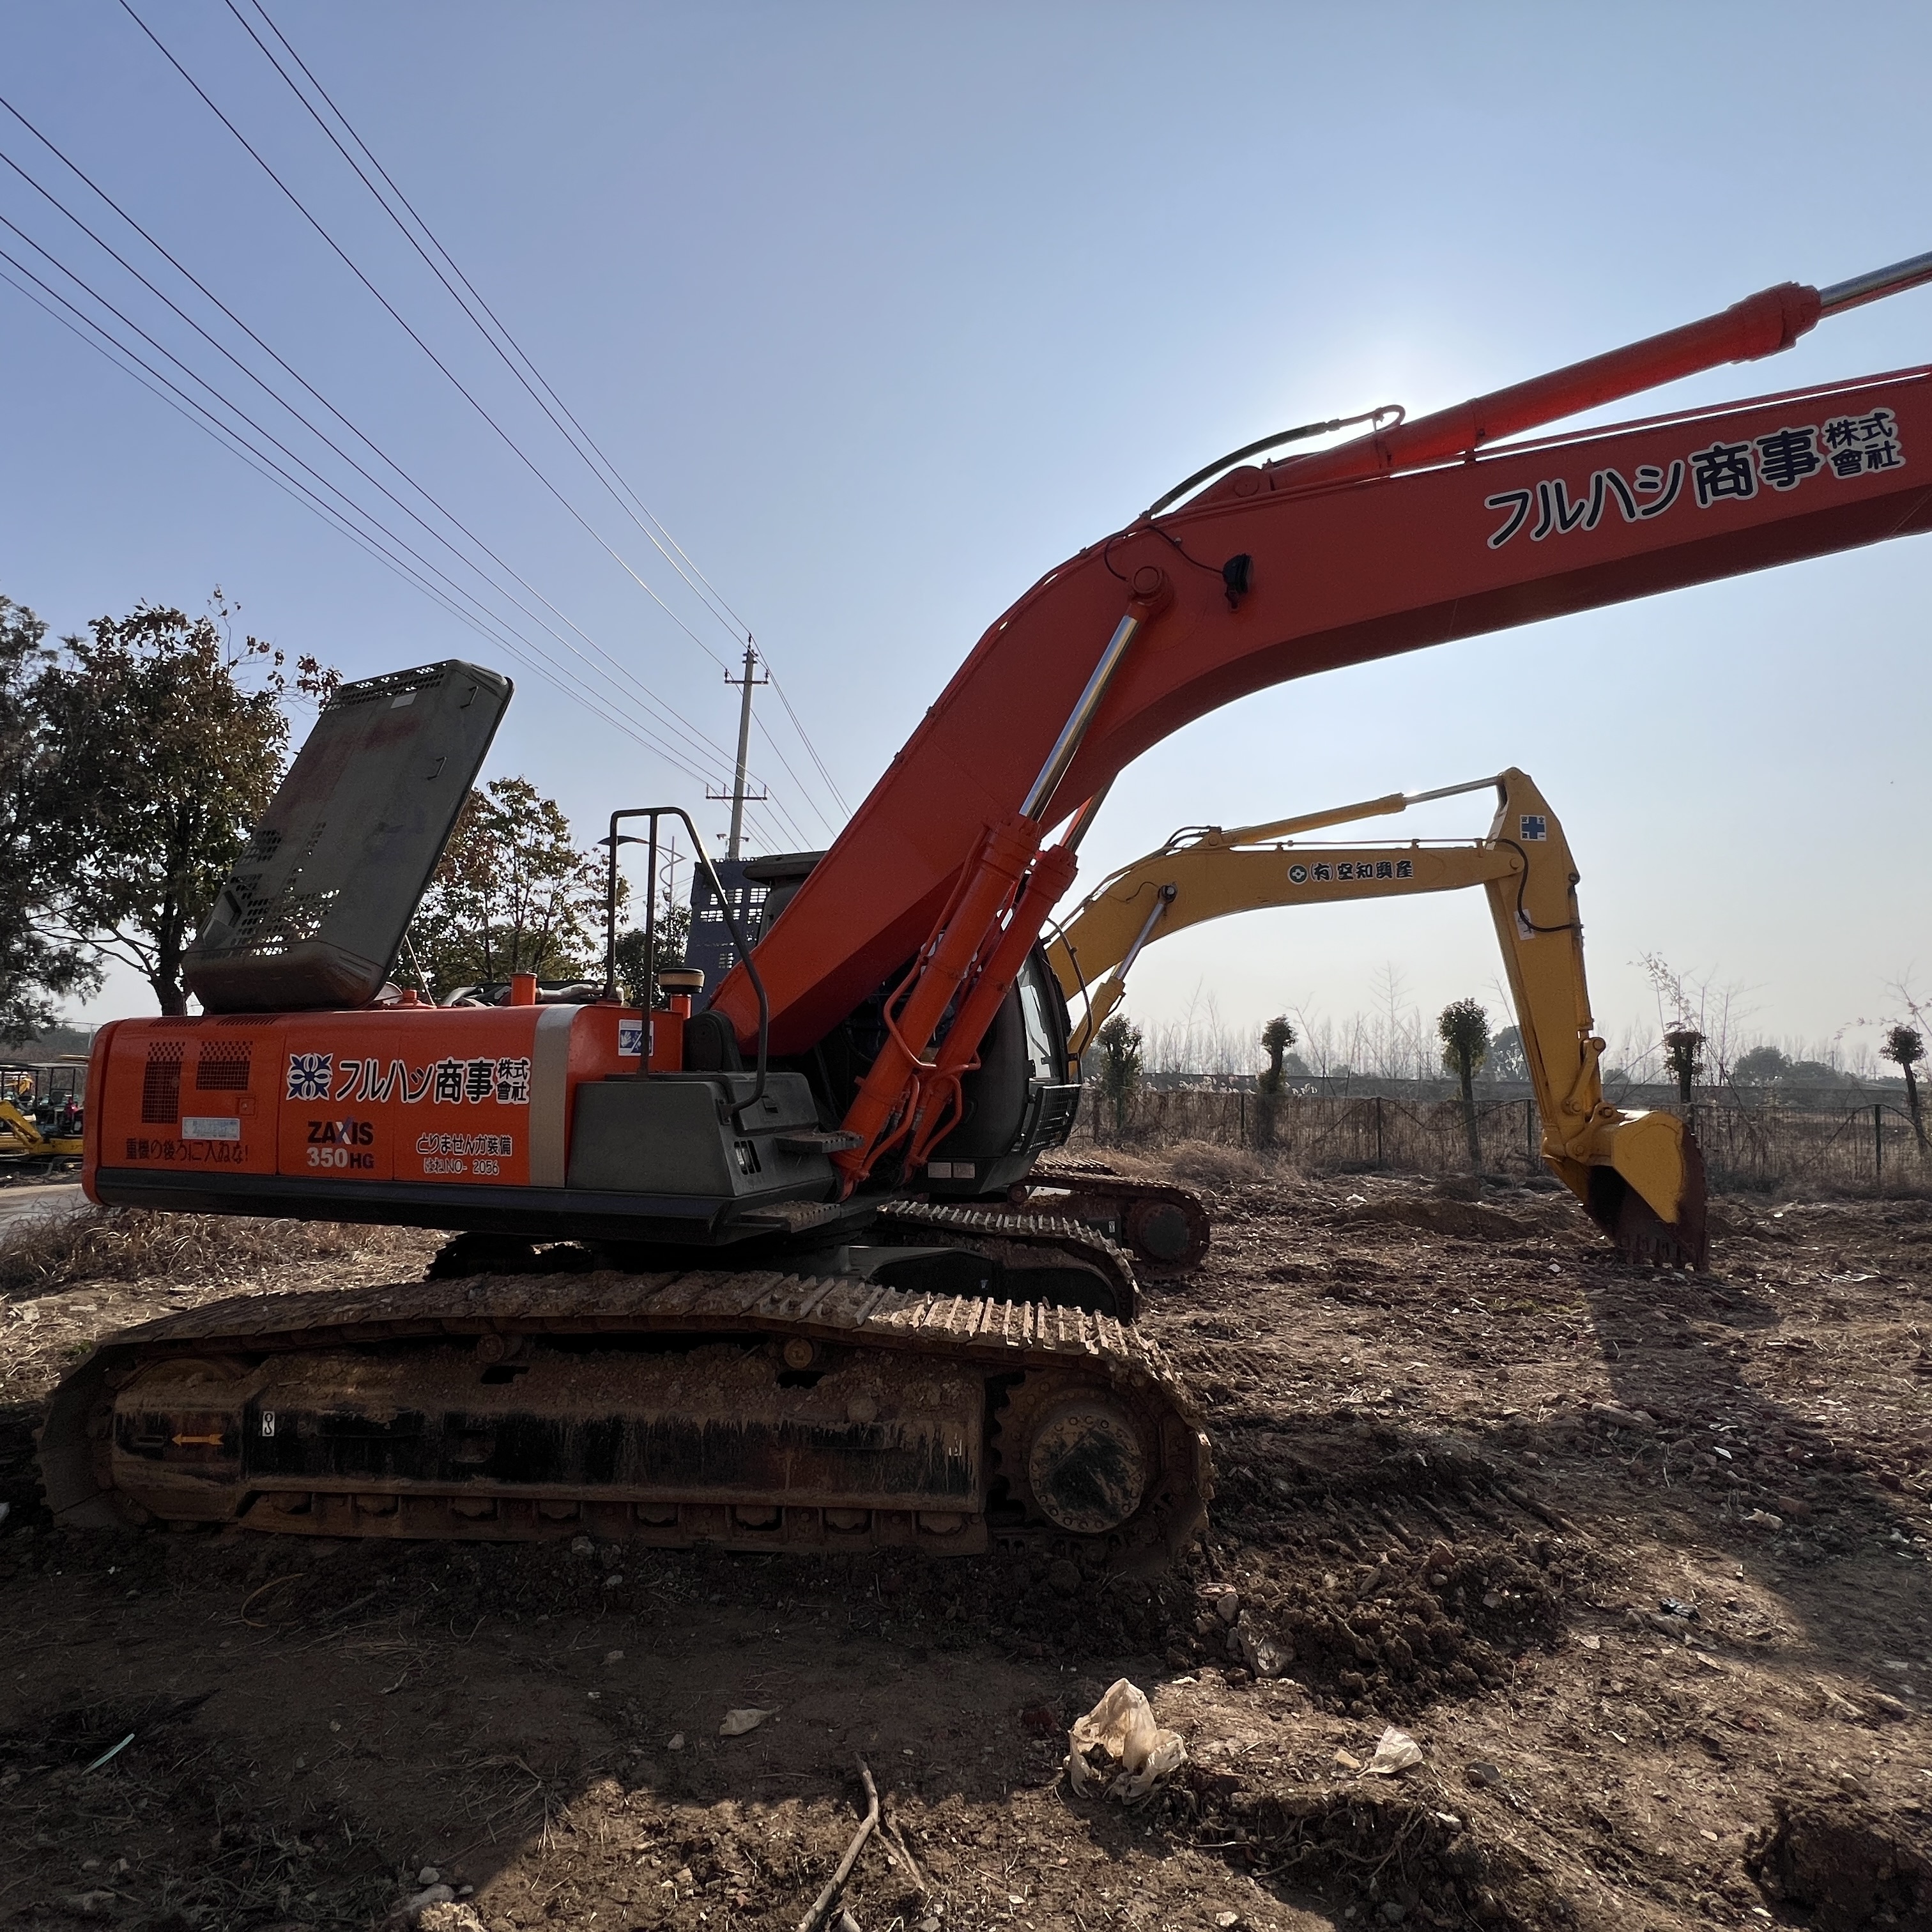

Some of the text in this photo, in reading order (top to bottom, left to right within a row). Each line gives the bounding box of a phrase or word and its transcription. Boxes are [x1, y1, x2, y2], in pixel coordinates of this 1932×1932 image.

[1485, 426, 1825, 549] フルハシ商事
[335, 1056, 496, 1104] フルハシ商事
[307, 1116, 374, 1146] ZAXIS
[472, 1159, 500, 1176] 2056
